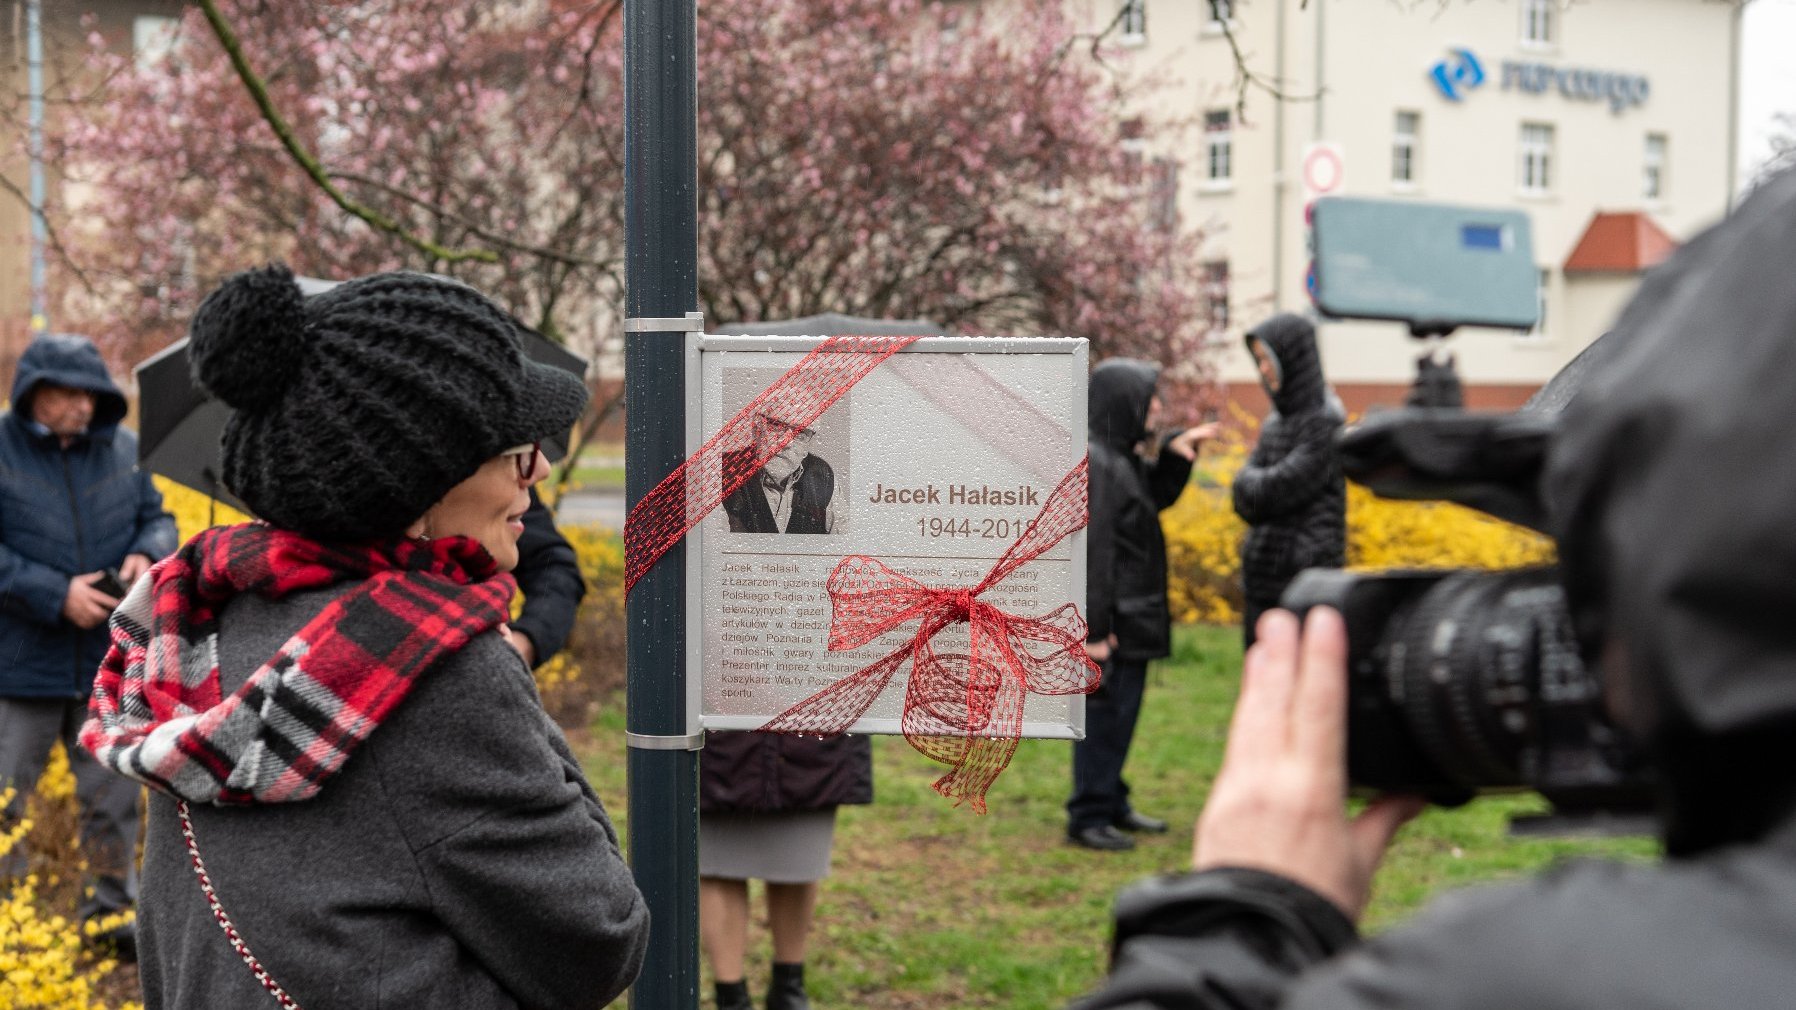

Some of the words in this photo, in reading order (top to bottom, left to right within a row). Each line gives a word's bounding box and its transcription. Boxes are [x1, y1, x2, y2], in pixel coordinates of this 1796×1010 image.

[869, 484, 941, 505] Jacek
[949, 485, 1040, 506] Hałasik
[722, 563, 752, 573] Jacek
[951, 567, 979, 580] życia
[722, 591, 770, 602] Polskiego
[796, 607, 826, 618] gazet
[766, 634, 812, 644] Poznania
[783, 650, 814, 660] gwary
[722, 659, 769, 670] Prezenter
[721, 674, 771, 686] koszykarz
